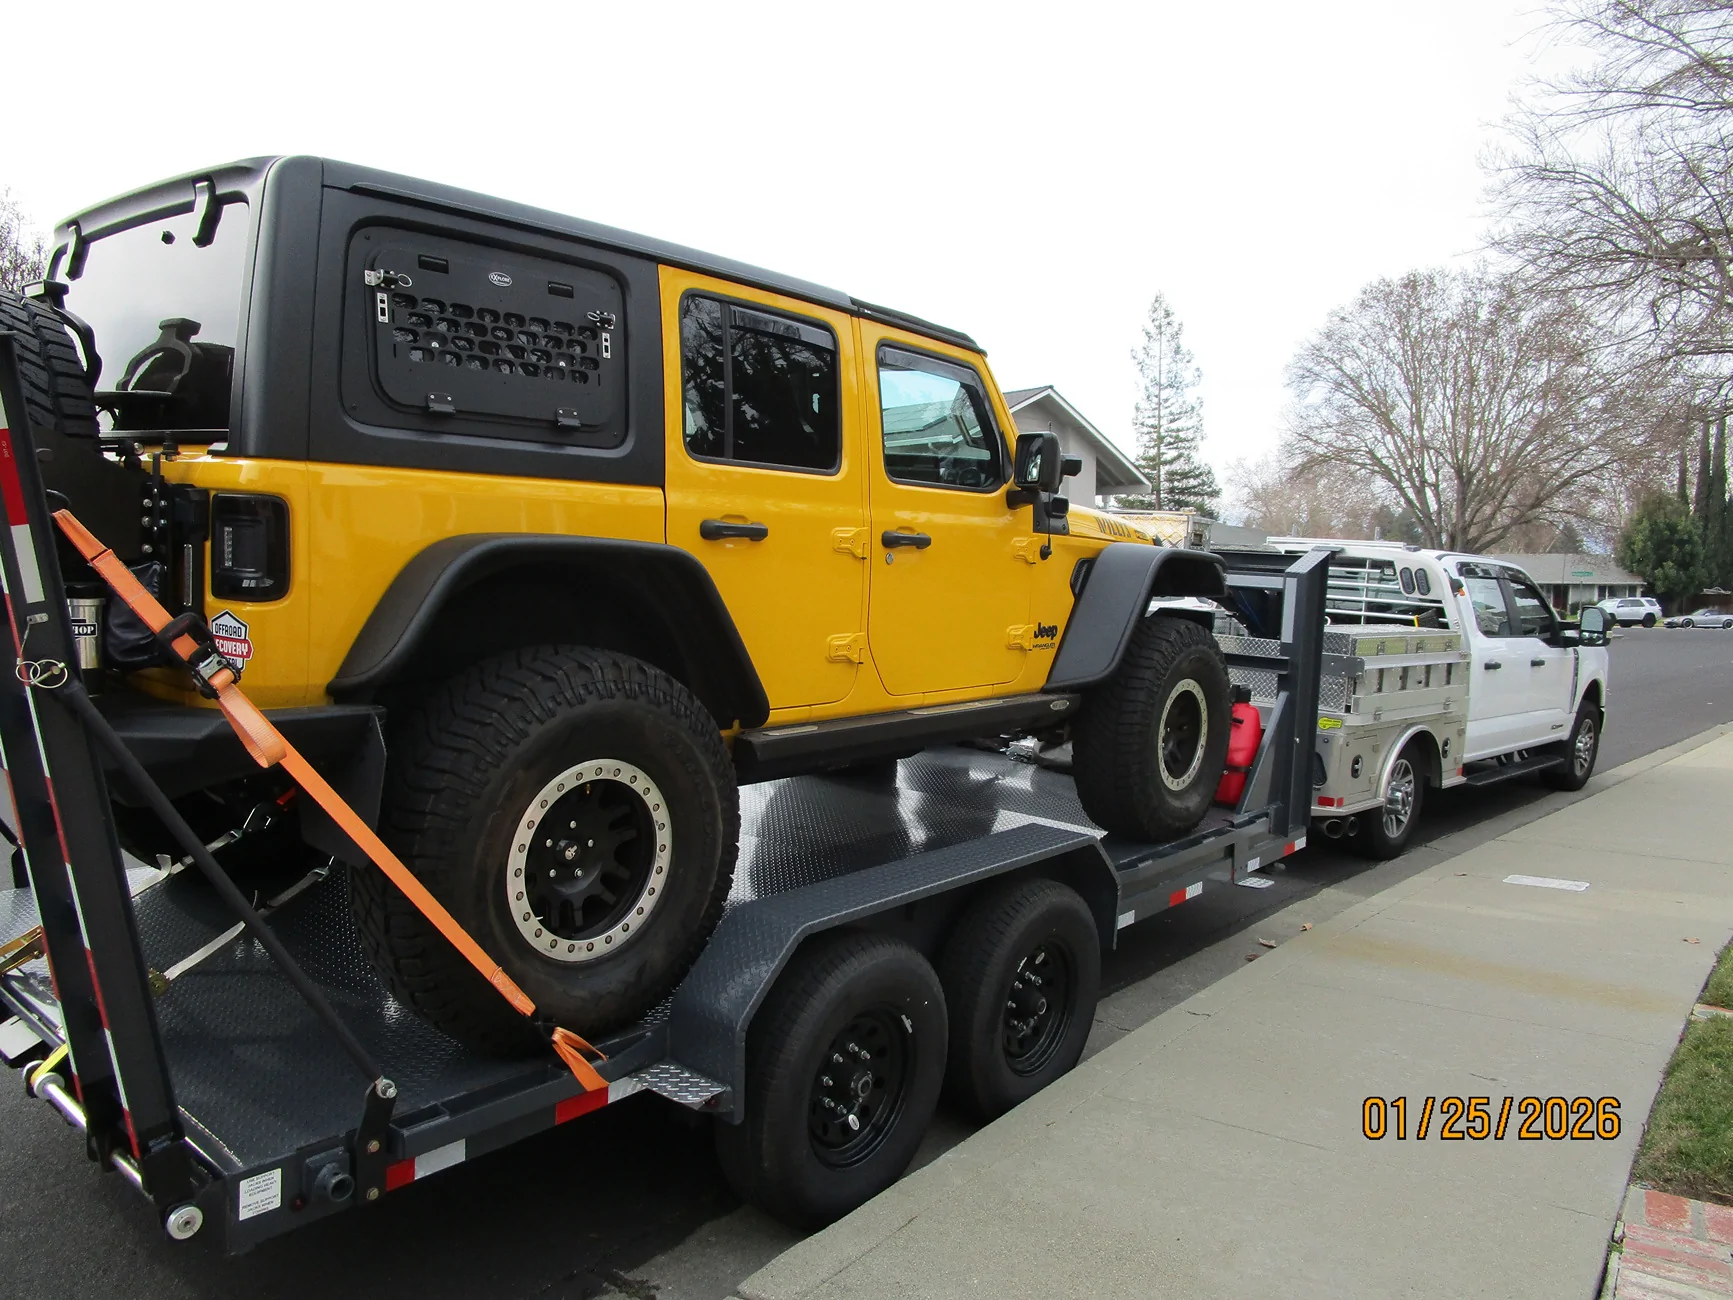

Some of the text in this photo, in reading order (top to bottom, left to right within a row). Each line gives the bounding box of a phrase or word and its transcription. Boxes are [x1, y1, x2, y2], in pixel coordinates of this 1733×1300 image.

[215, 623, 241, 637] OFFROAD
[1034, 622, 1057, 640] Jeep
[215, 639, 248, 655] ECOVERY
